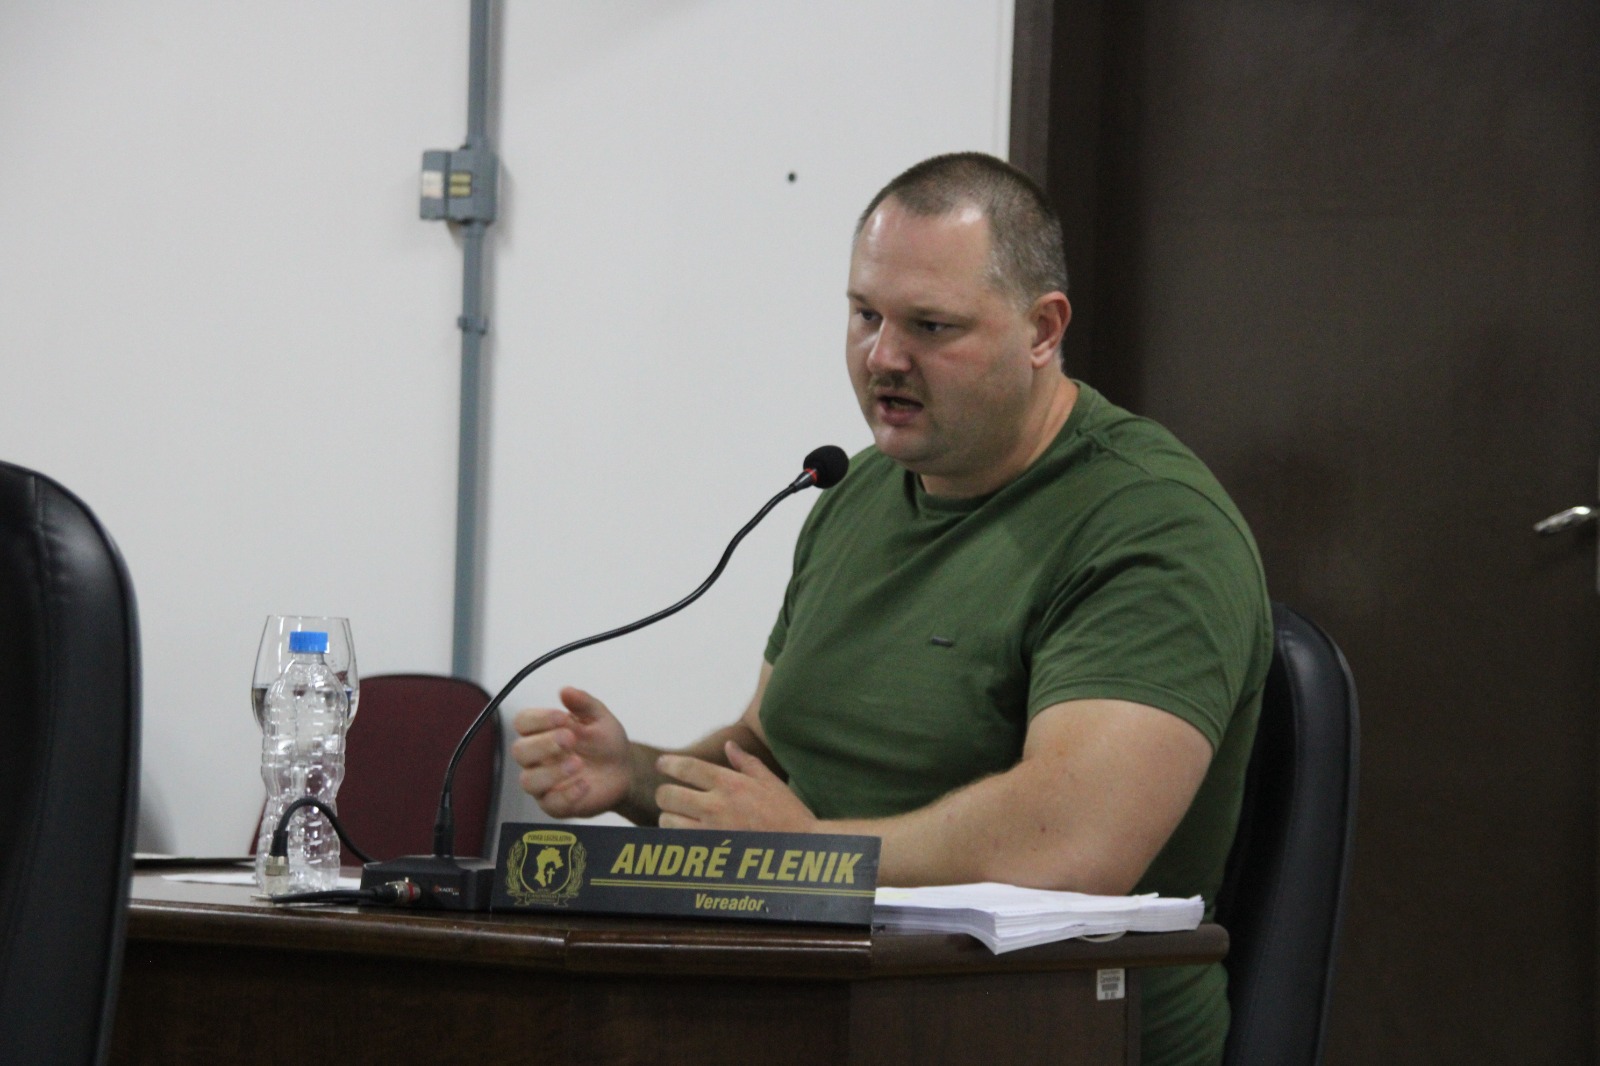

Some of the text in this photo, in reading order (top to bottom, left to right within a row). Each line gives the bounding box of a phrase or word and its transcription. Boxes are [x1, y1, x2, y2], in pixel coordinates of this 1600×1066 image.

[611, 839, 863, 884] ANDRÉ FLENIK
[695, 892, 764, 912] Vereador
